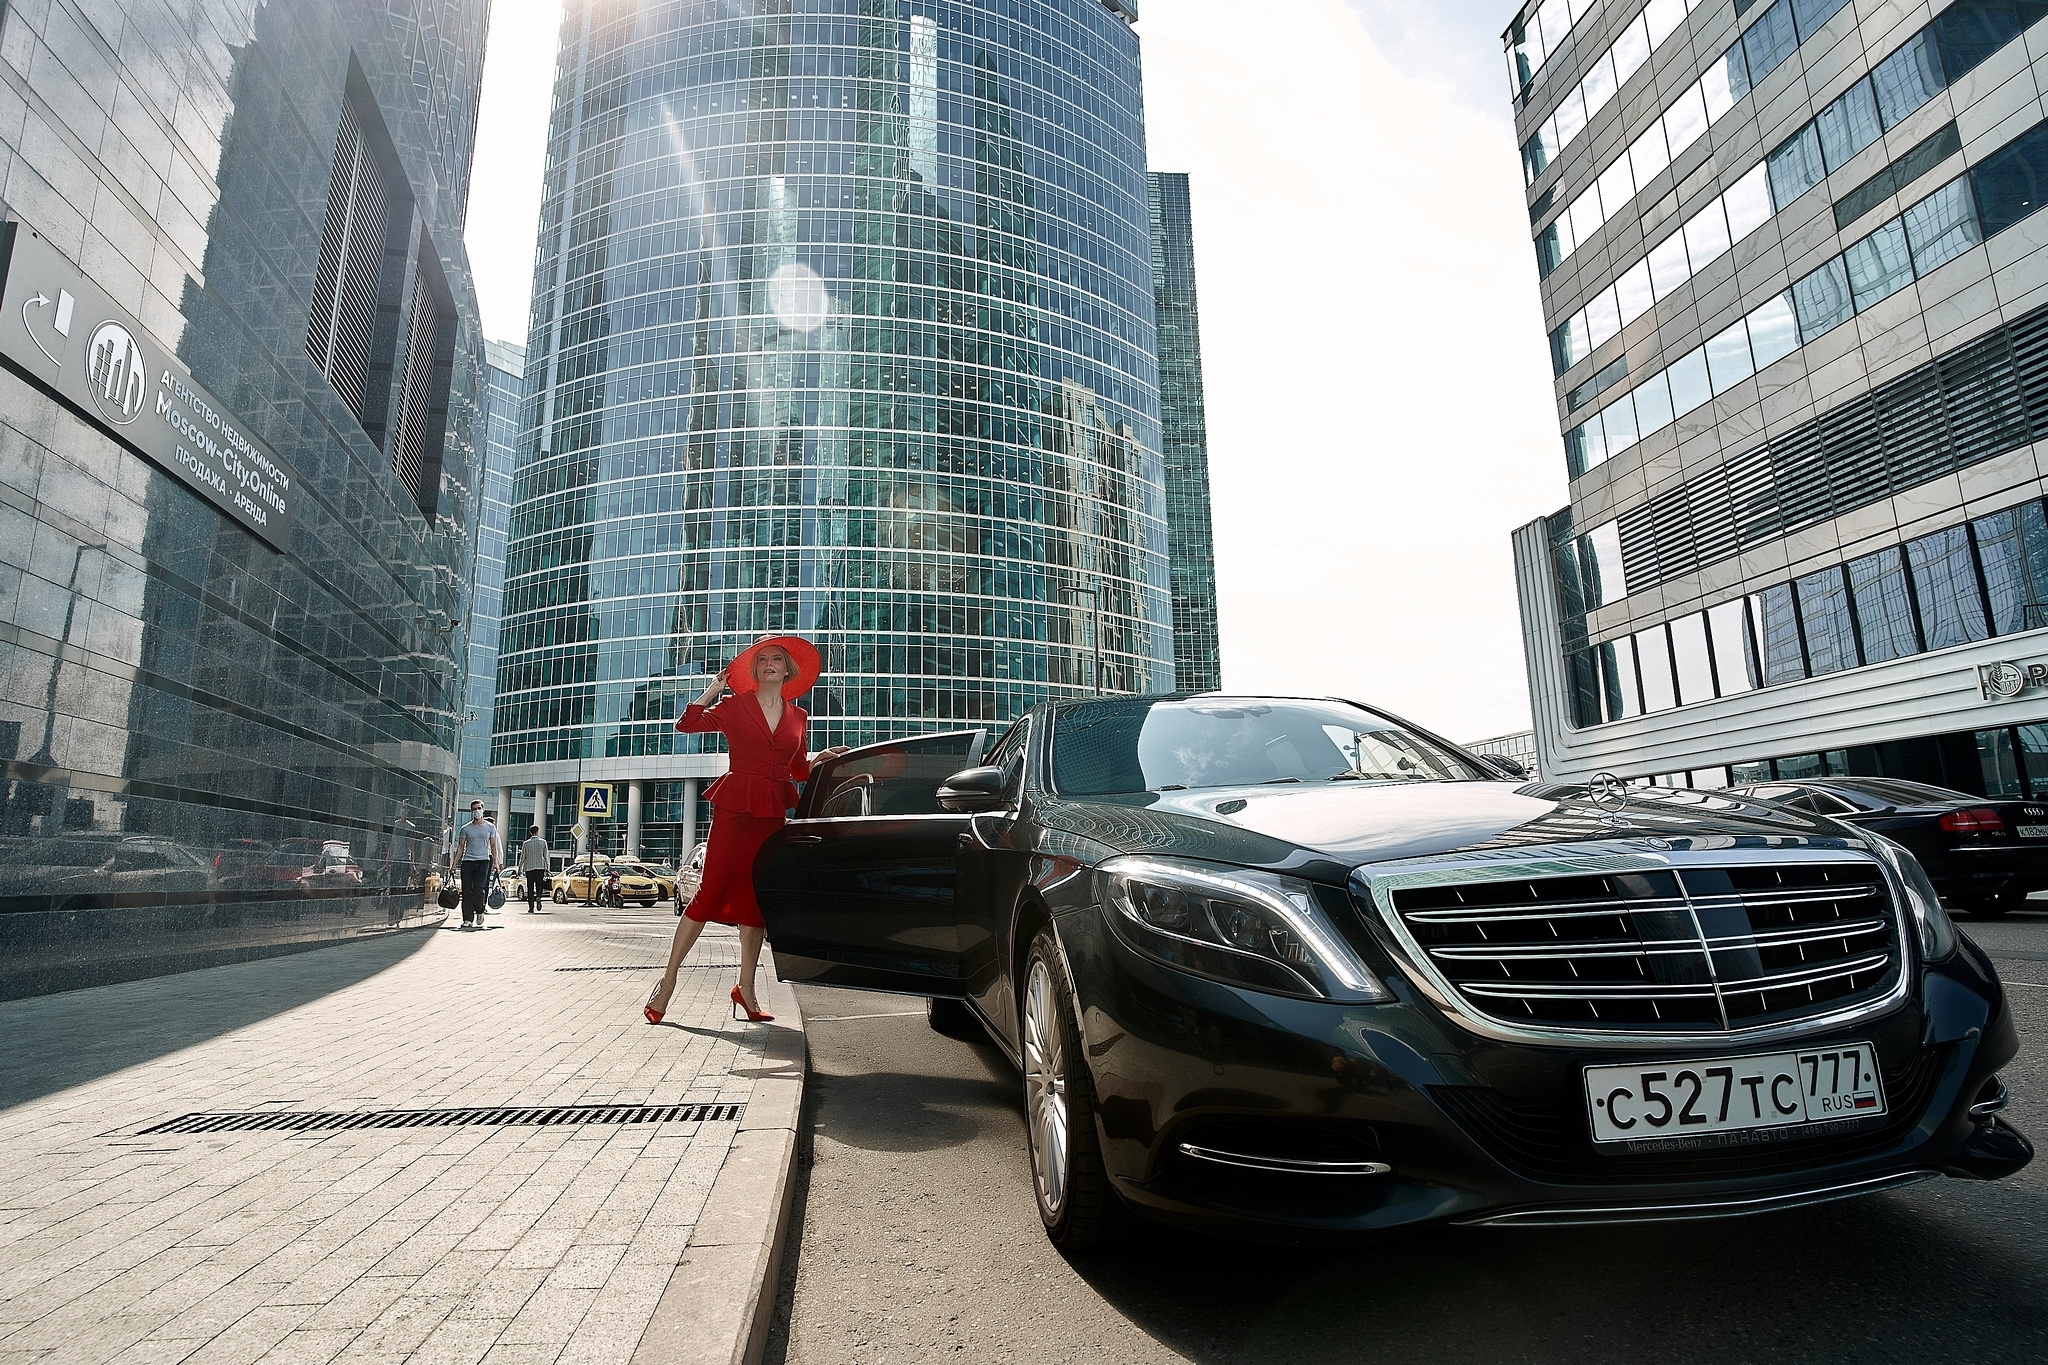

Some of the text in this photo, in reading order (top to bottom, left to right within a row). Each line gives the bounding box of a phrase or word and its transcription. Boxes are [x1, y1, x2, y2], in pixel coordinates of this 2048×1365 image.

[160, 369, 290, 491] АГЕНТСТВО НЕДВИЖИМОСТИ
[174, 444, 267, 527] ПРОДАЖА АРЕНДА
[1801, 1049, 1861, 1097] 777
[1822, 1095, 1854, 1112] RUS
[1626, 1119, 1861, 1153] Mercedes-Benz ПАНАВТО (495) 790-7777
